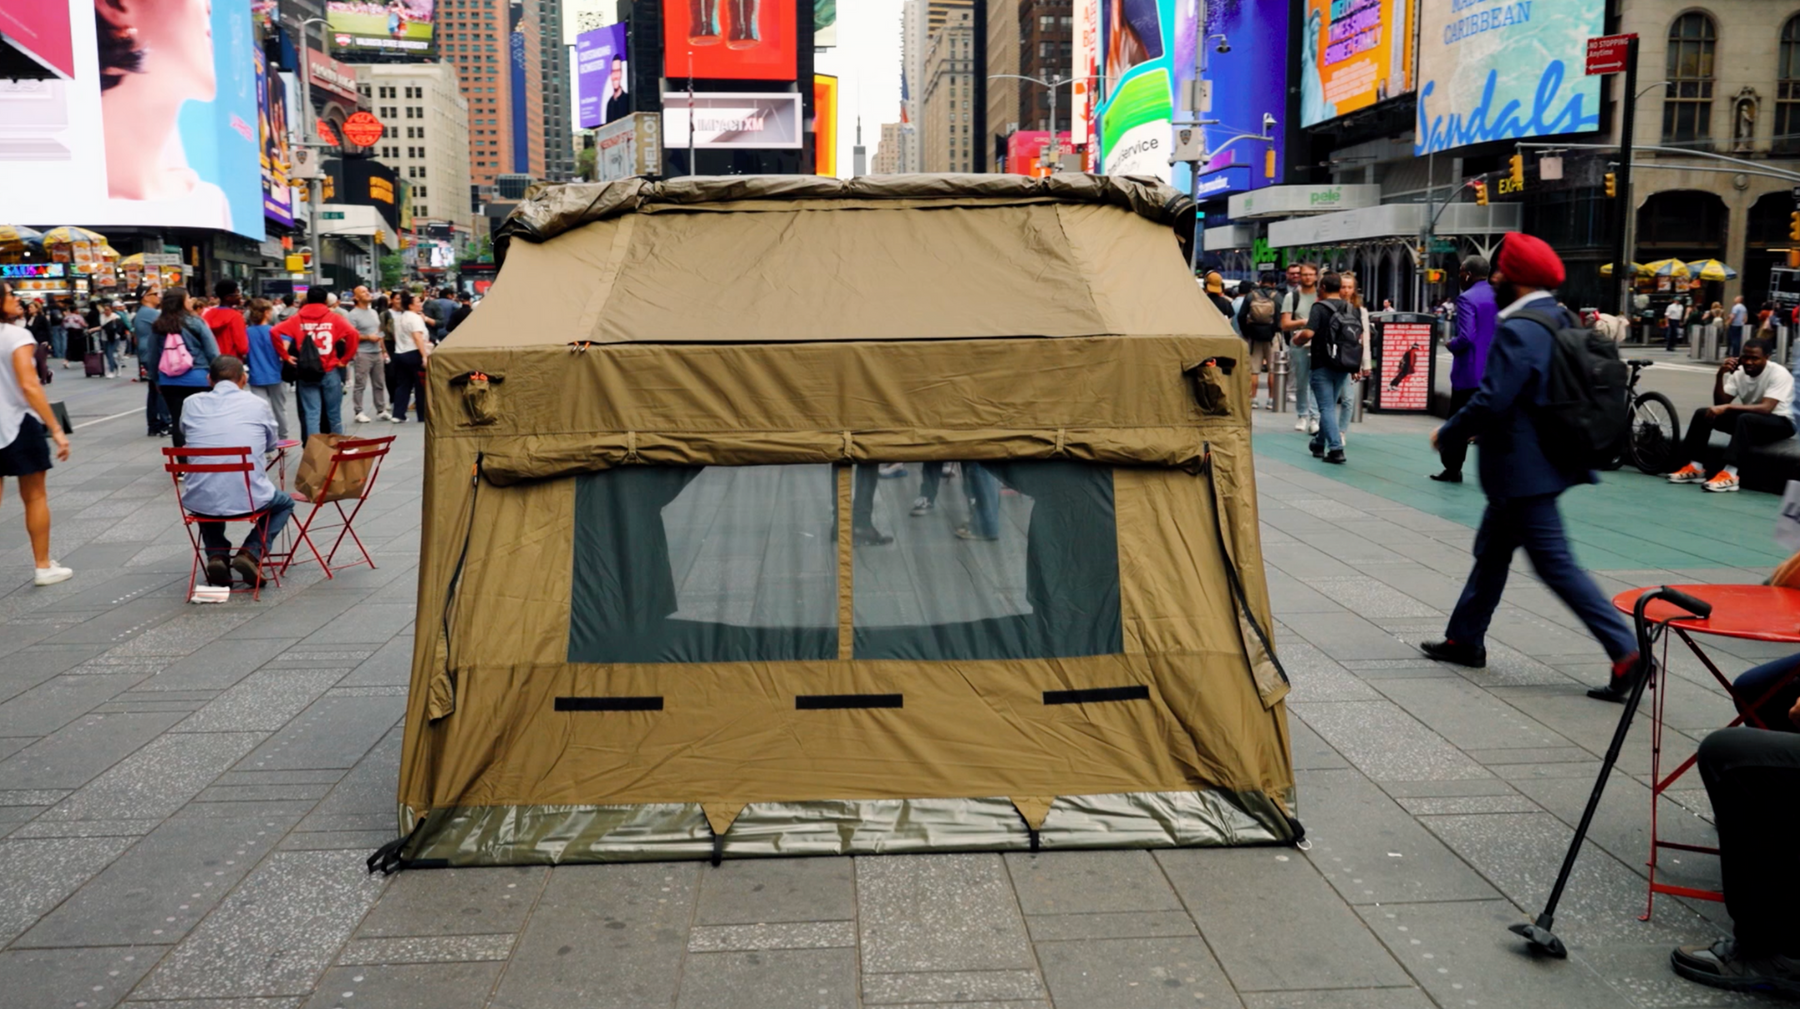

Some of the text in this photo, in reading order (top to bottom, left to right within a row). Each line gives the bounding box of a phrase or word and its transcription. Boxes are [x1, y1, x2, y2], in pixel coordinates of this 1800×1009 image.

[1444, 1, 1531, 45] CARIBBEAN
[1589, 49, 1614, 58] Anytime
[1599, 37, 1629, 48] STOPPING
[1414, 60, 1599, 157] Sandals
[697, 117, 764, 131] IMPACTXM
[643, 116, 657, 173] HELLO!
